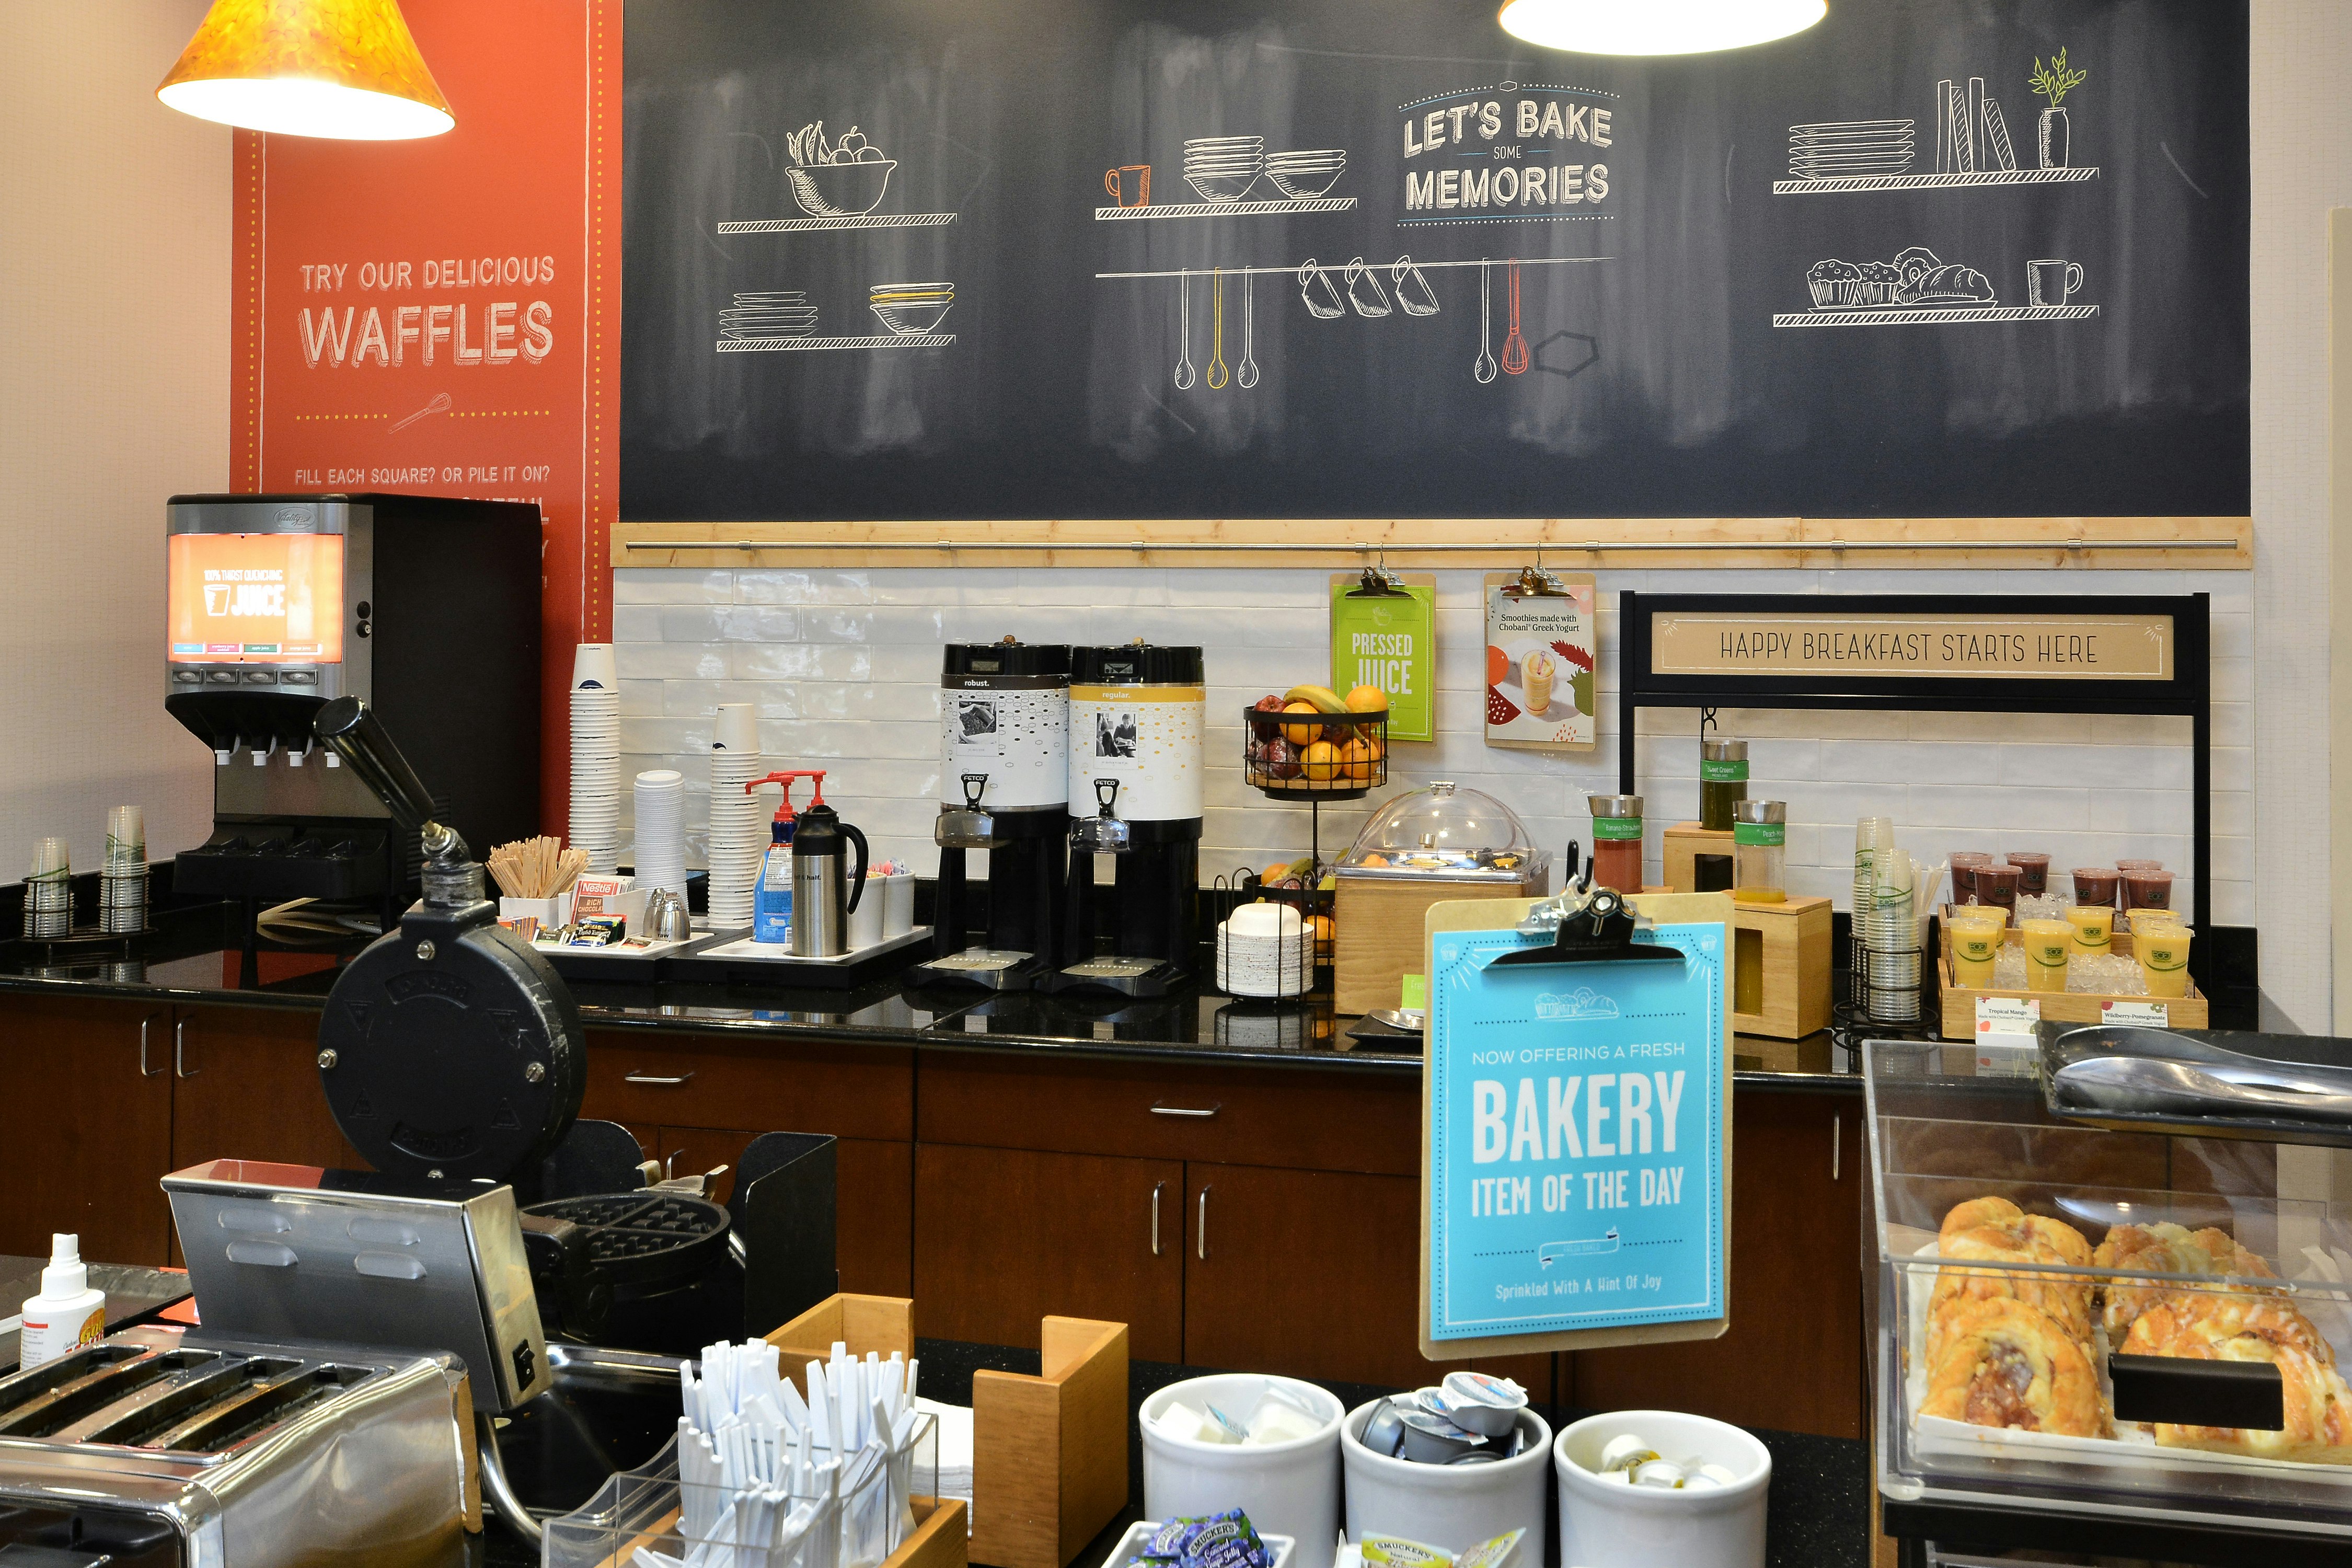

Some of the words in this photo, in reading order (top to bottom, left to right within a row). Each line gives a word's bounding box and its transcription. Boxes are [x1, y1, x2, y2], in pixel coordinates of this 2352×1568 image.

[1404, 101, 1502, 158] LET'S
[1516, 100, 1612, 148] BAKE
[1494, 145, 1522, 160] SOME
[1405, 163, 1609, 210] MEMORIES
[301, 263, 348, 291] TRY
[359, 261, 412, 290] OUR
[423, 255, 555, 288] DELICIOUS
[298, 301, 553, 369] WAFFLES
[295, 469, 322, 485] FILL
[327, 468, 365, 484] EACH
[371, 467, 435, 483] SQUARE?
[442, 467, 463, 482] OR
[468, 466, 498, 483] PILE
[503, 466, 515, 482] IT
[523, 465, 550, 482] ON?
[230, 584, 285, 616] JUICE
[1501, 614, 1539, 622] Smoothies
[1540, 614, 1560, 622] made
[1561, 614, 1577, 622] with
[1555, 624, 1579, 633] Yogurt
[1352, 633, 1413, 656] PRESSED
[1720, 632, 1792, 660] HAPPY
[1803, 632, 1932, 661] BREAKFAST
[1942, 634, 2025, 663] STARTS
[2038, 635, 2097, 663] HERE
[1352, 659, 1412, 695] JUICE
[1473, 1050, 1515, 1065] NOW
[1520, 1045, 1609, 1063] OFFERING
[1614, 1046, 1625, 1058] A
[1630, 1042, 1685, 1057] FRESH
[1473, 1070, 1686, 1164] BAKERY
[1472, 1176, 1531, 1217] ITEM
[1542, 1173, 1573, 1213] OF
[1583, 1170, 1629, 1210] THE
[1640, 1167, 1684, 1206] DAY
[1495, 1283, 1548, 1301] Sprinkled
[1553, 1281, 1580, 1296] With
[1585, 1280, 1593, 1293] A
[1597, 1278, 1620, 1292] Hint
[1625, 1275, 1639, 1289] Of
[1641, 1274, 1662, 1292] Joy
[1191, 1524, 1234, 1553] SMUCKER'S
[1204, 1538, 1230, 1560] Concord
[1390, 1551, 1420, 1562] Natural
